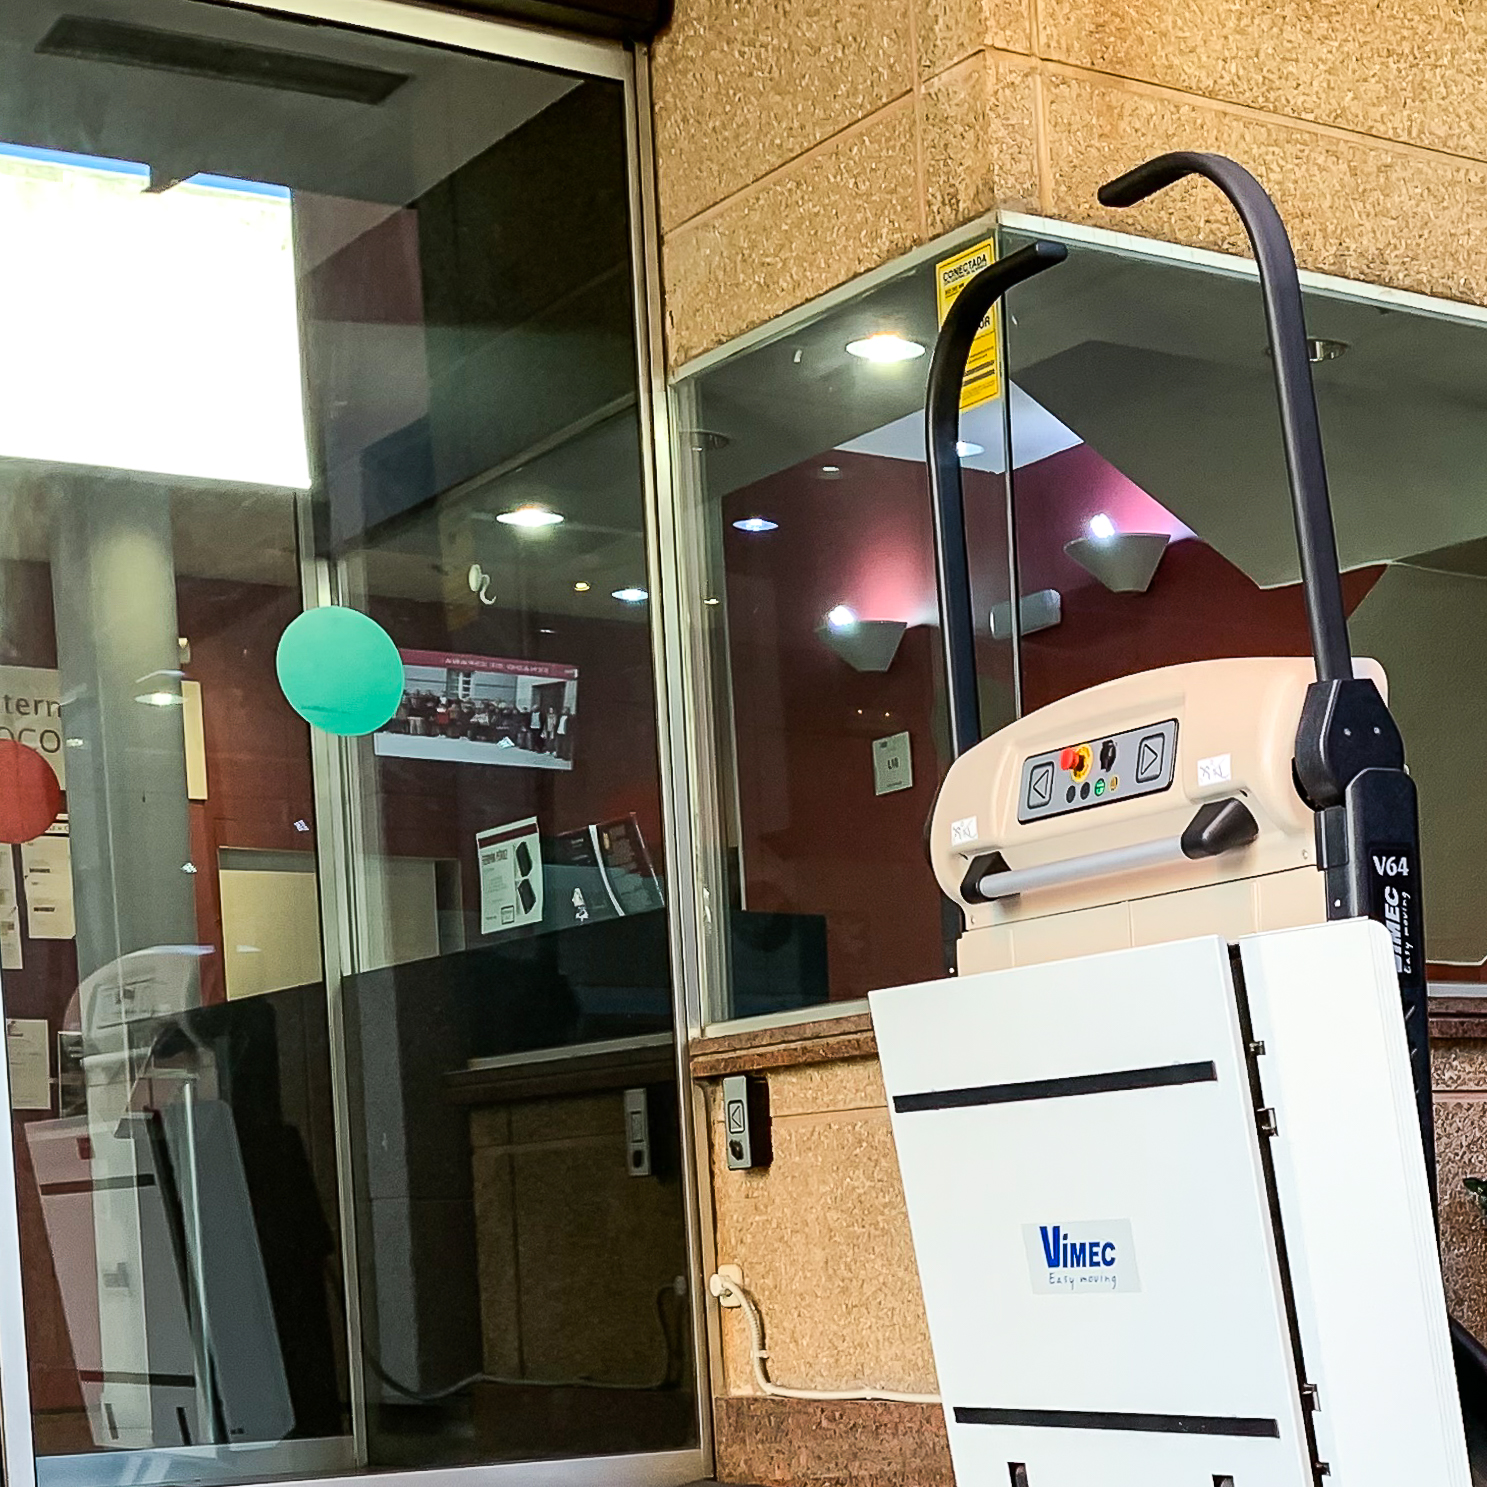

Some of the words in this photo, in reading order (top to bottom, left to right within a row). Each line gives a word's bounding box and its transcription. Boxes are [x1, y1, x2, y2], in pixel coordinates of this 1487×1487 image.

[942, 254, 987, 282] CONECTADA
[1372, 855, 1410, 877] V64
[1049, 1272, 1075, 1291] Easy
[1080, 1275, 1117, 1290] moving
